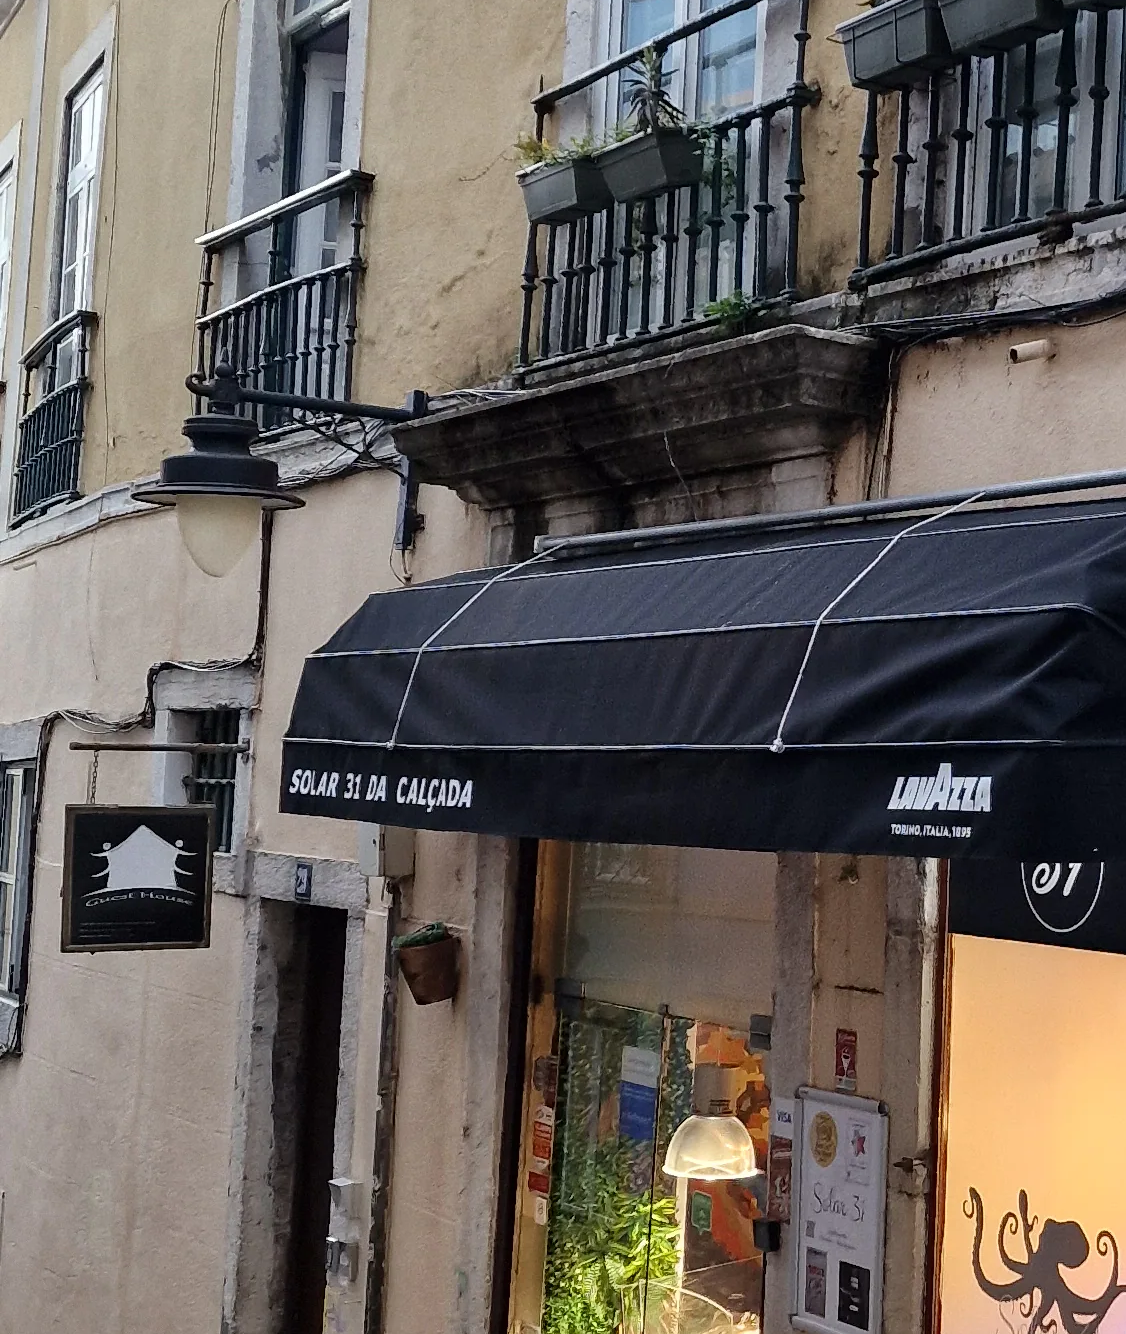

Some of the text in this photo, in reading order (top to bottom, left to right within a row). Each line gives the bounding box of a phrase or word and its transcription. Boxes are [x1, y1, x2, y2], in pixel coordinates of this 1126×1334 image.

[288, 768, 474, 813] SOLAR 31 DA CALÇADA
[886, 762, 993, 813] LAVAZZA
